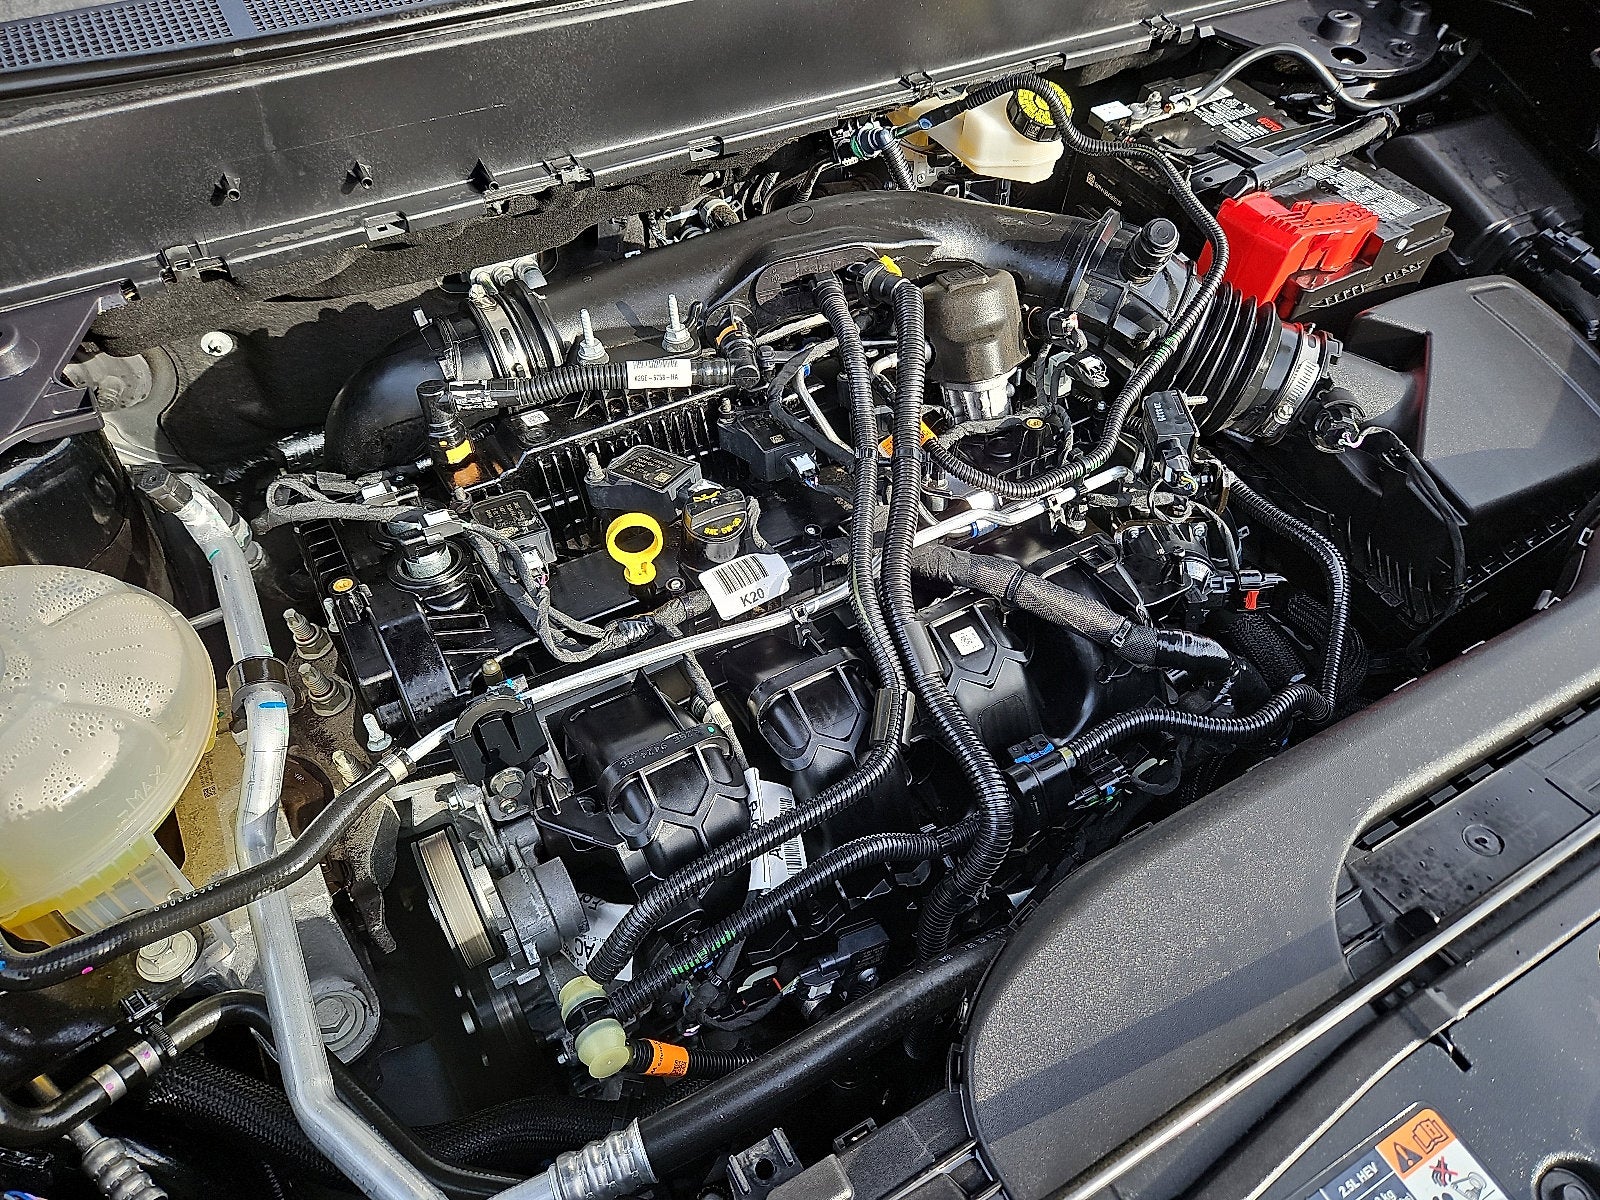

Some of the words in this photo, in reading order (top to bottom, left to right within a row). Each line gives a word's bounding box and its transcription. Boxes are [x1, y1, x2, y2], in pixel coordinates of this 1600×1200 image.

[740, 587, 765, 607] K20
[125, 765, 168, 810] MAX
[1337, 1173, 1362, 1199] 2.5L
[1359, 1161, 1380, 1185] HEV
